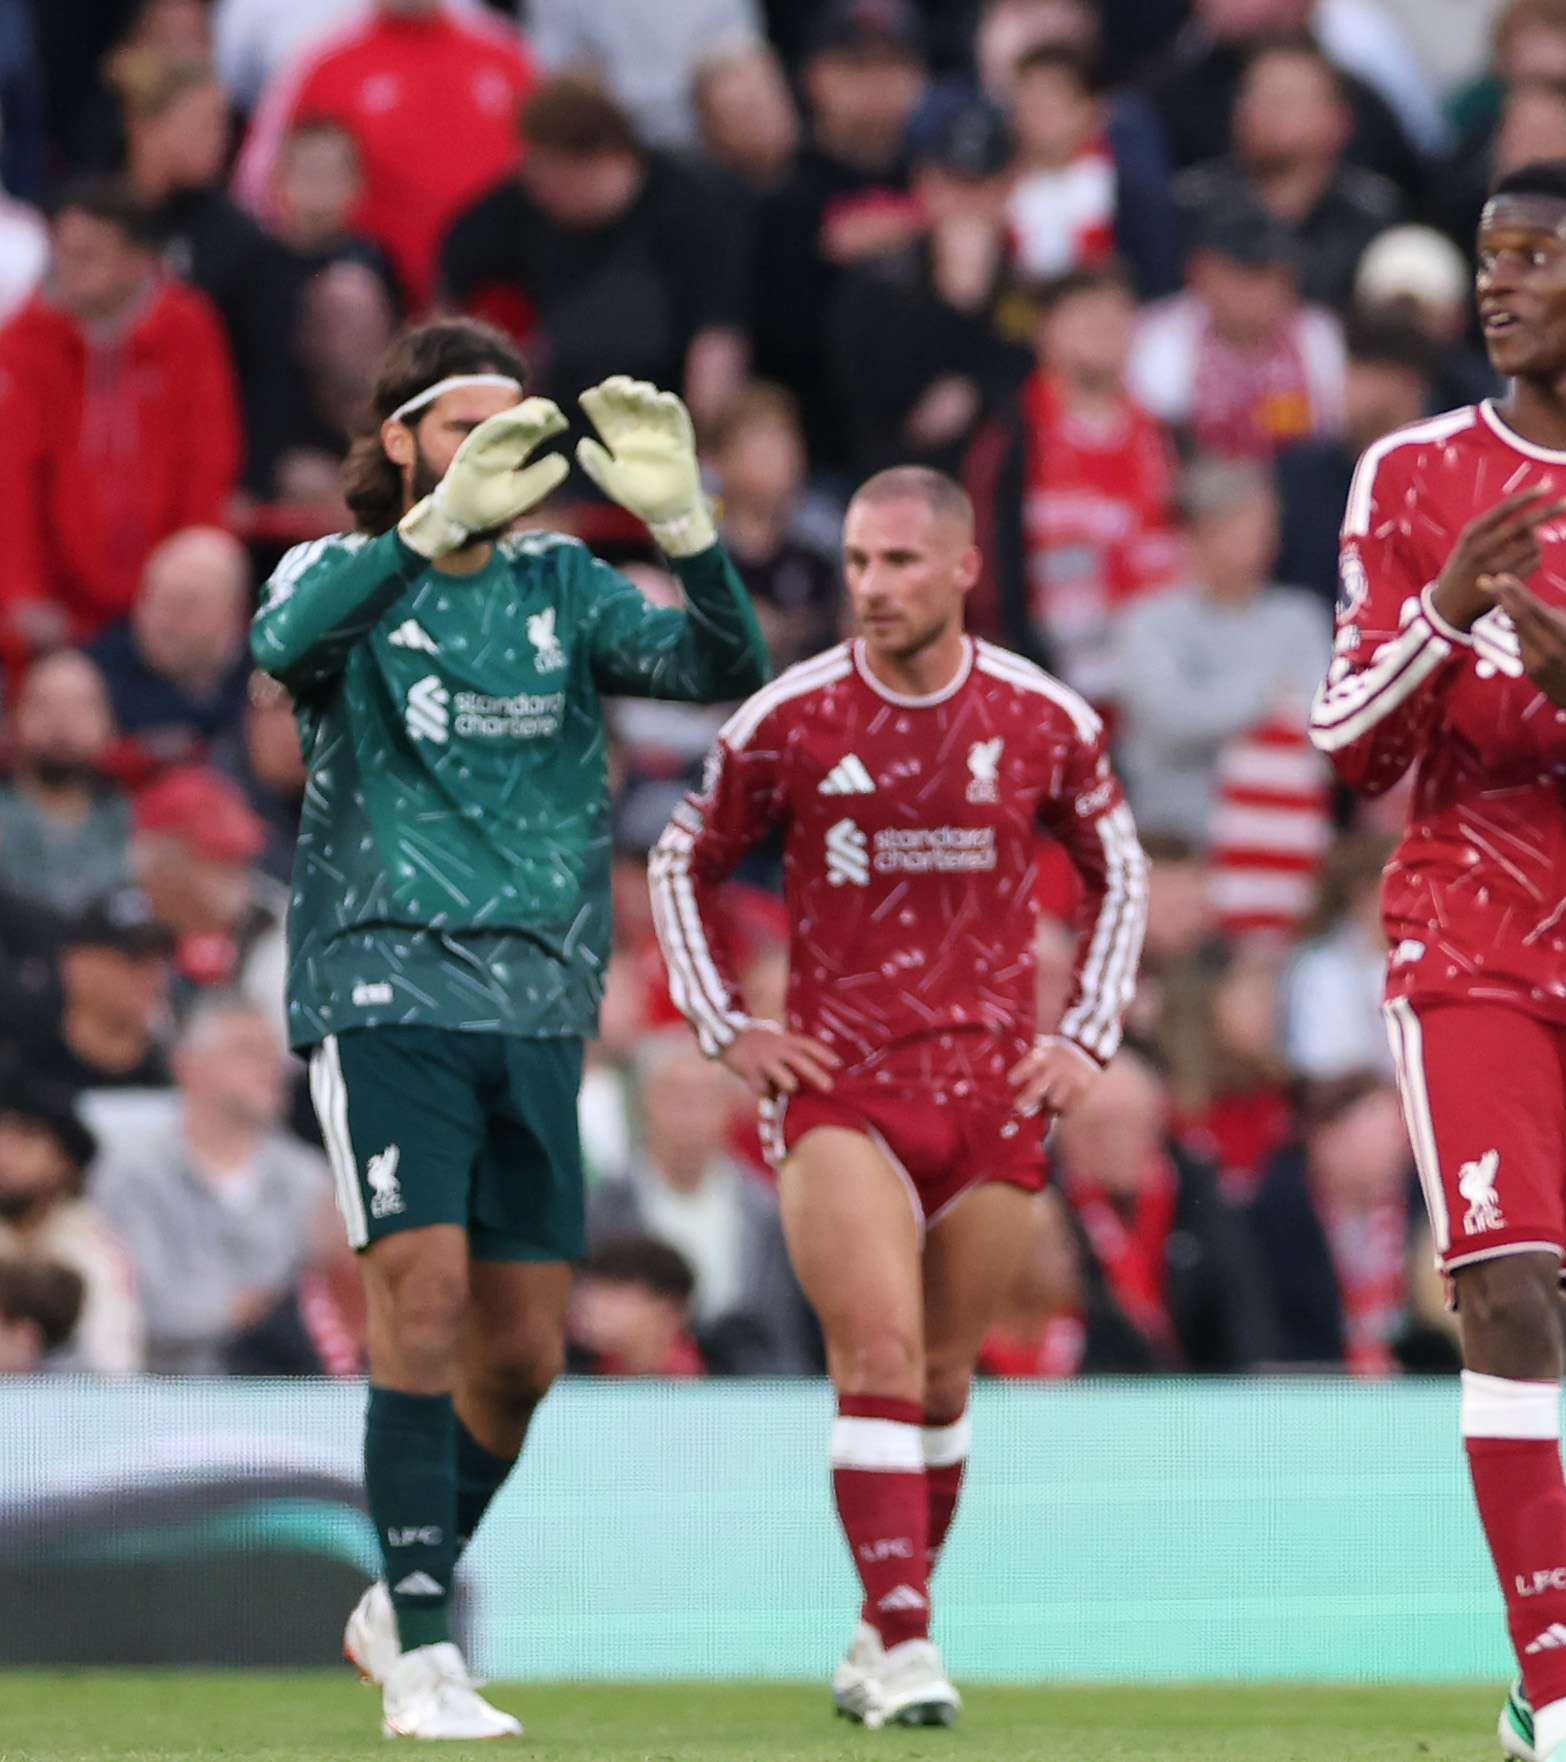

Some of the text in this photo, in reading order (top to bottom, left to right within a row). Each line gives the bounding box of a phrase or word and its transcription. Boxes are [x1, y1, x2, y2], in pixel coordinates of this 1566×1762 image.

[454, 691, 566, 717] standard
[874, 825, 995, 849] standard
[874, 847, 997, 873] chartered
